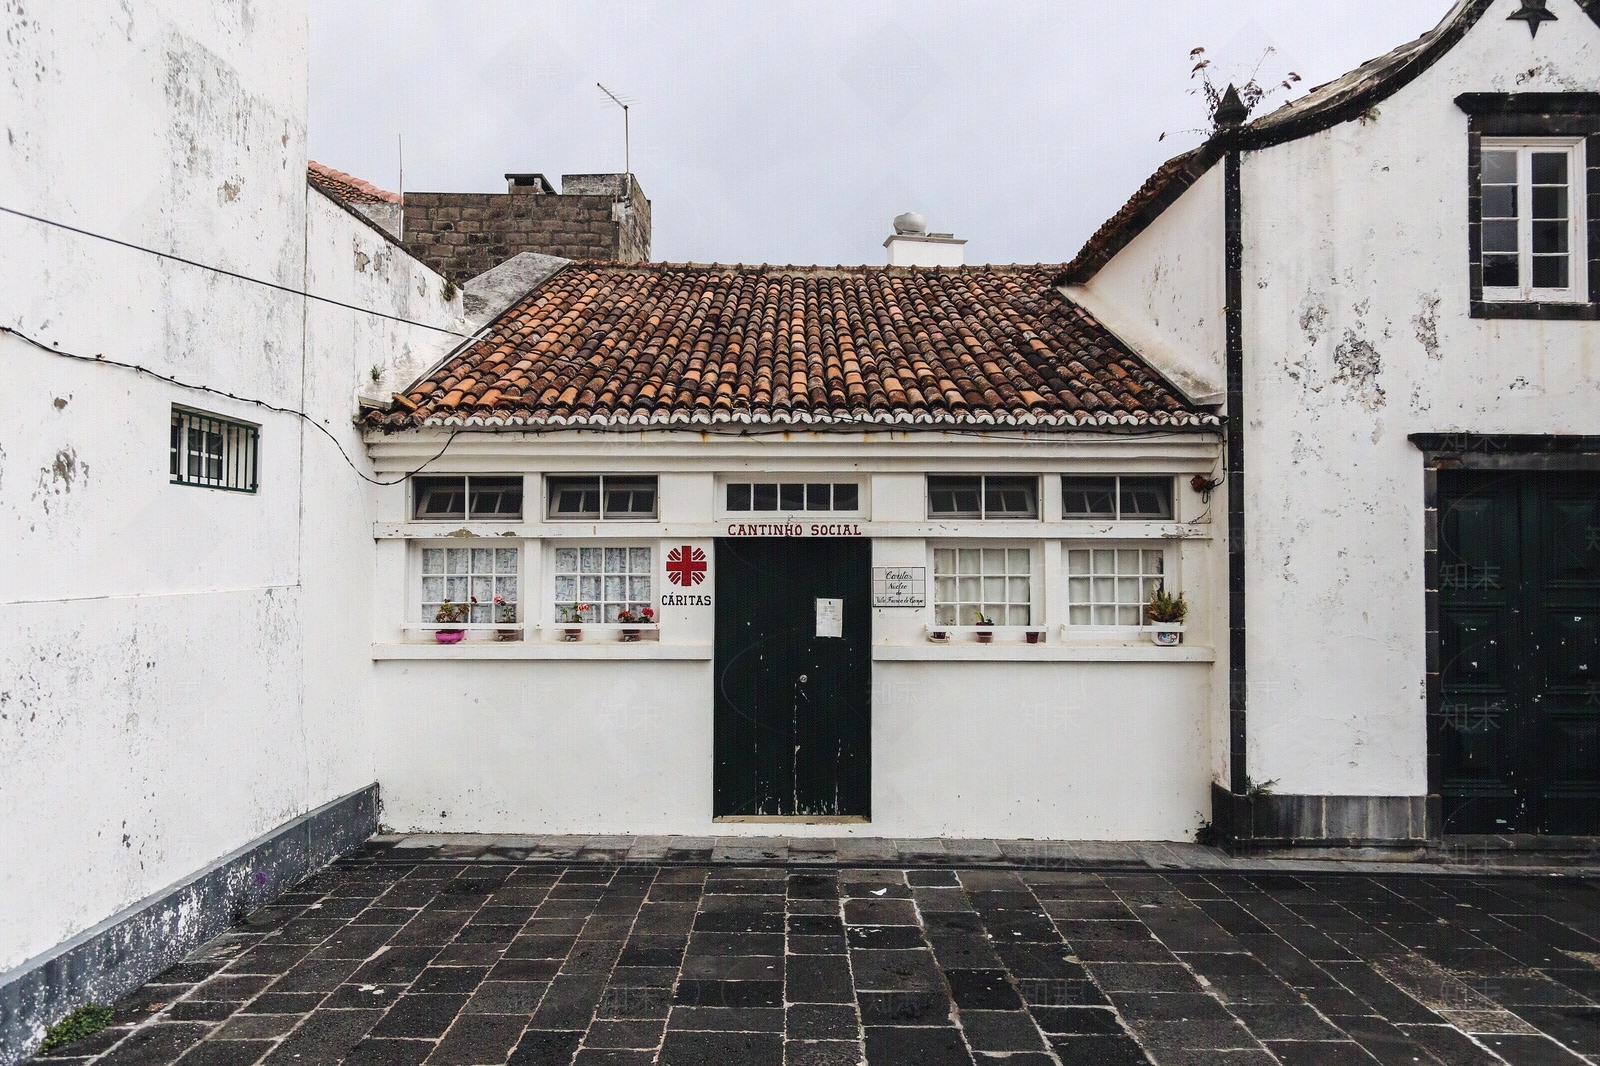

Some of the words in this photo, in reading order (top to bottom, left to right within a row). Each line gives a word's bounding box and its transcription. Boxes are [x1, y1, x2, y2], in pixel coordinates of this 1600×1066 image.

[728, 524, 803, 536] CANTINHO
[811, 524, 862, 536] SOCIAL
[661, 591, 712, 606] CÁRITAS
